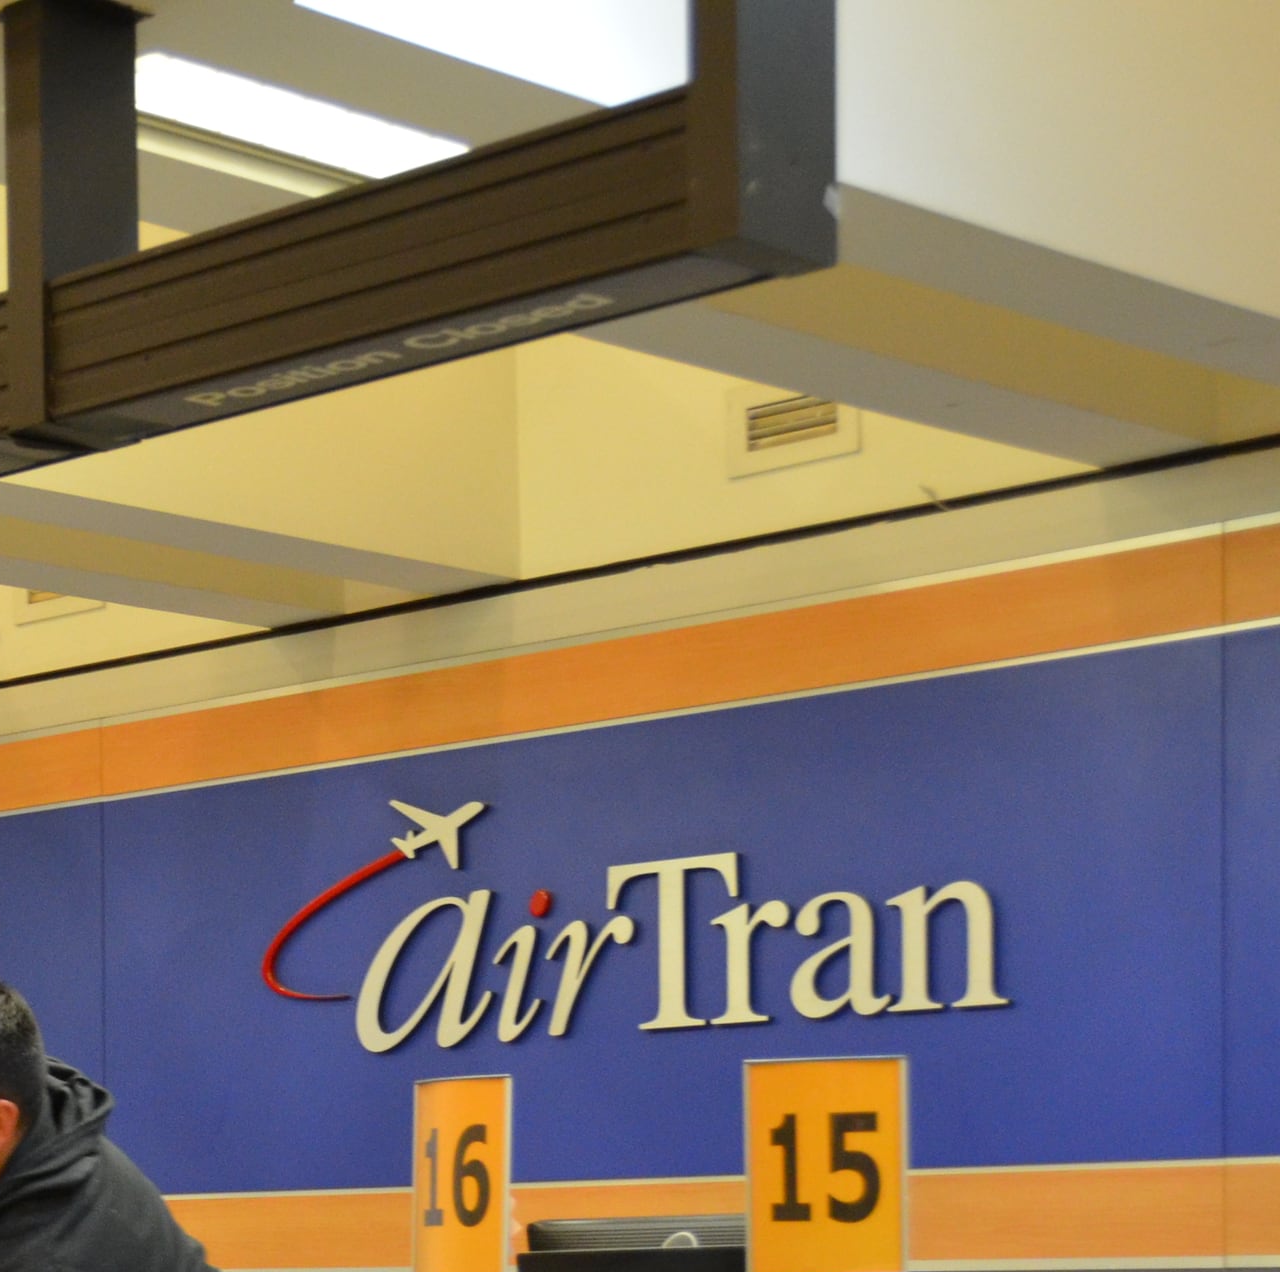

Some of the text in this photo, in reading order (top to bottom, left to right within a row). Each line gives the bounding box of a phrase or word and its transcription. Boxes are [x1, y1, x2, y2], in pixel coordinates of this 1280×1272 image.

[184, 293, 615, 409] Position Closed
[355, 851, 1011, 1054] airTran
[424, 1123, 491, 1227] 16
[770, 1112, 881, 1224] 15
